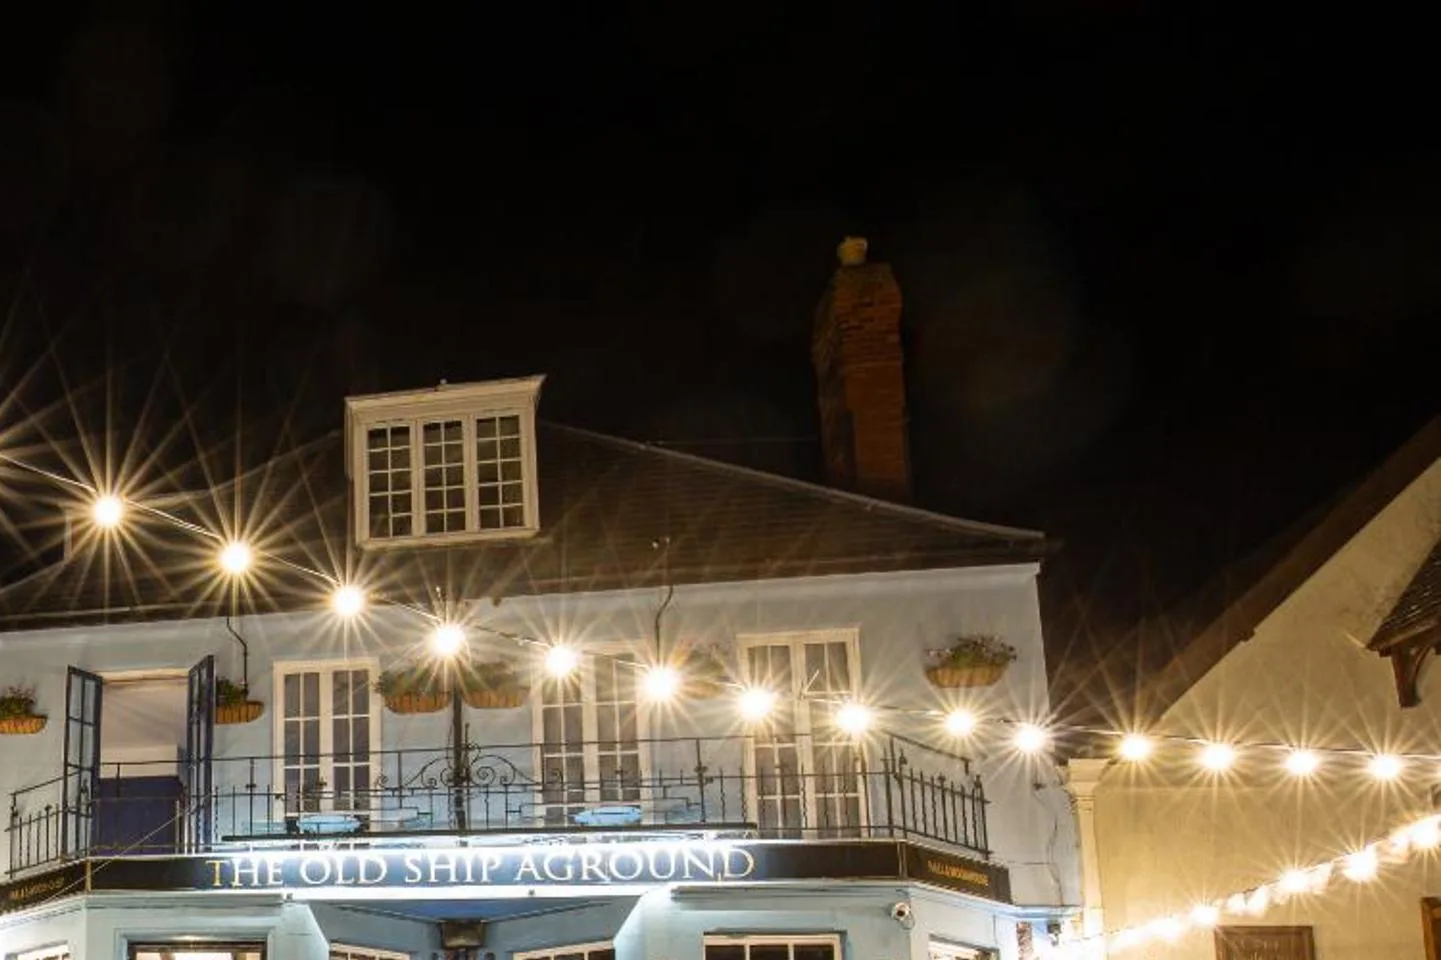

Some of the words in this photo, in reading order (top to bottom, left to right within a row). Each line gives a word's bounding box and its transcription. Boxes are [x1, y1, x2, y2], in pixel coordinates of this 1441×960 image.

[205, 858, 283, 889] THE
[299, 856, 387, 887] OLD
[404, 852, 501, 884] SHIP
[513, 847, 757, 883] AGROUND
